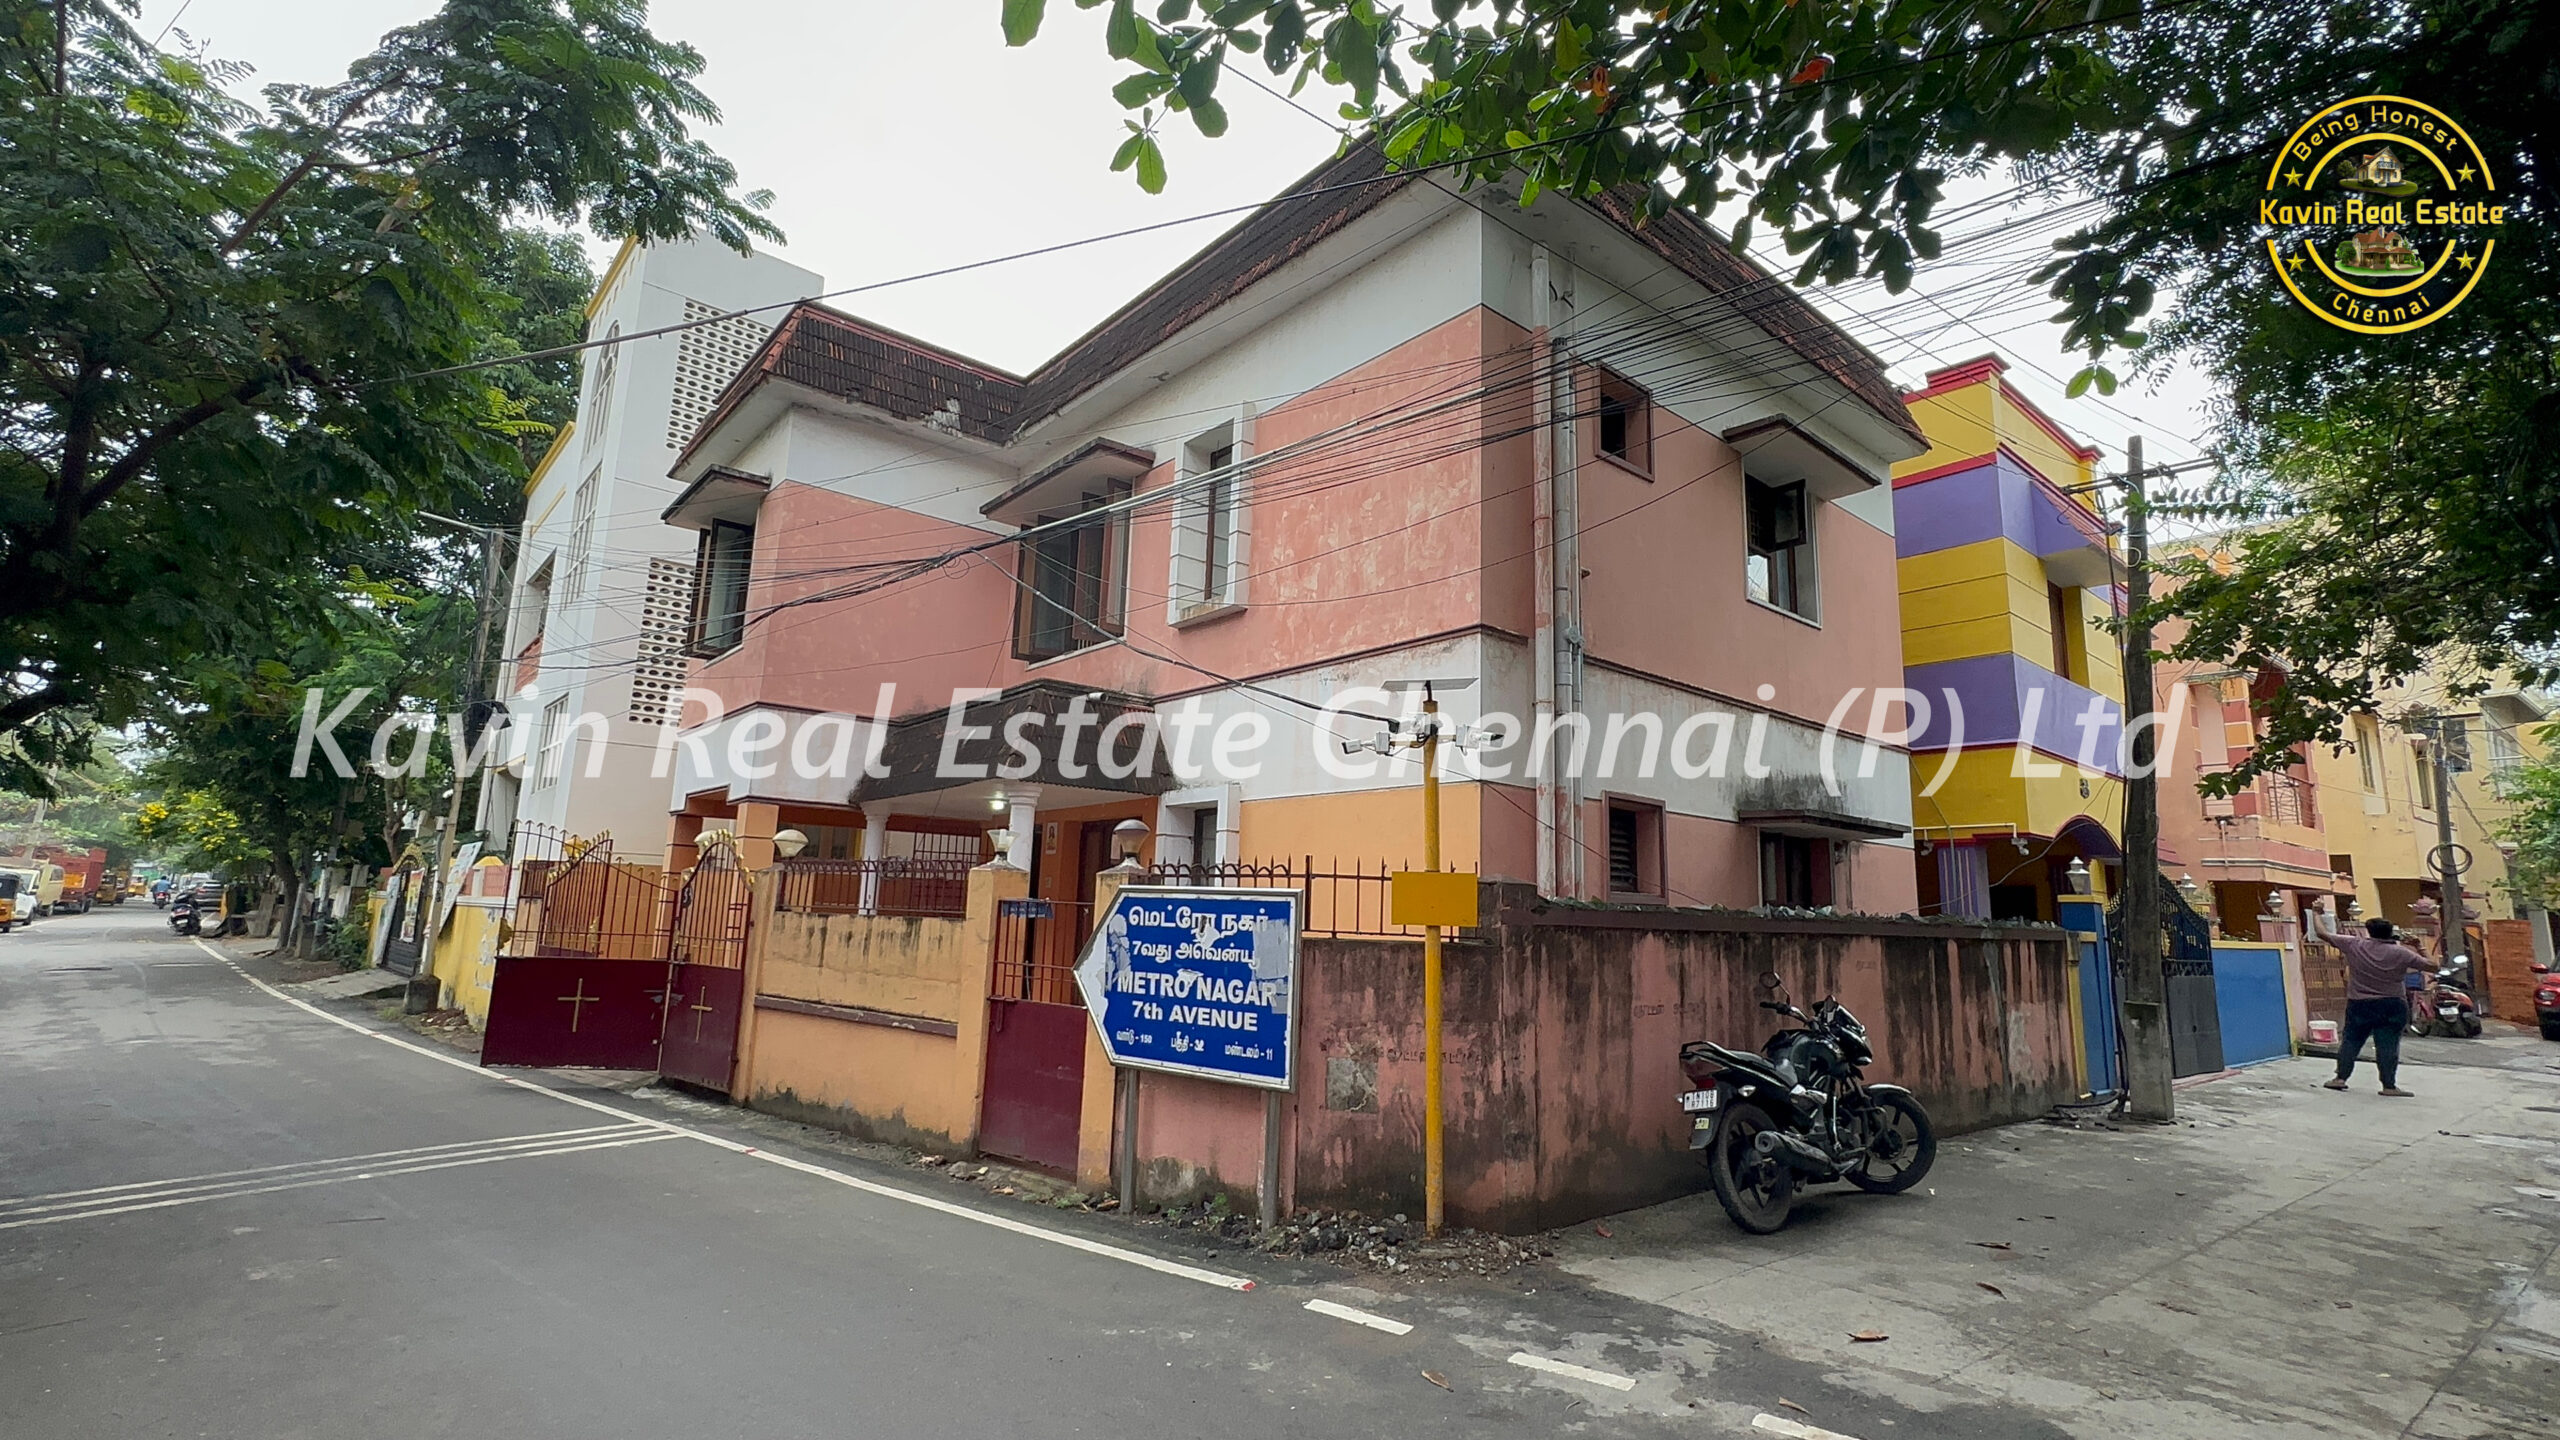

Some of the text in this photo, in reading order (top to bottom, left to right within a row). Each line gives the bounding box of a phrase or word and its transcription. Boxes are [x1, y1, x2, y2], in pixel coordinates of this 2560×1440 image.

[1219, 907, 1270, 938] நகர்
[1132, 940, 1171, 963] 7வது
[1117, 971, 1278, 1007] METRO NAGAR
[1132, 1000, 1258, 1031] 7th AVENUE
